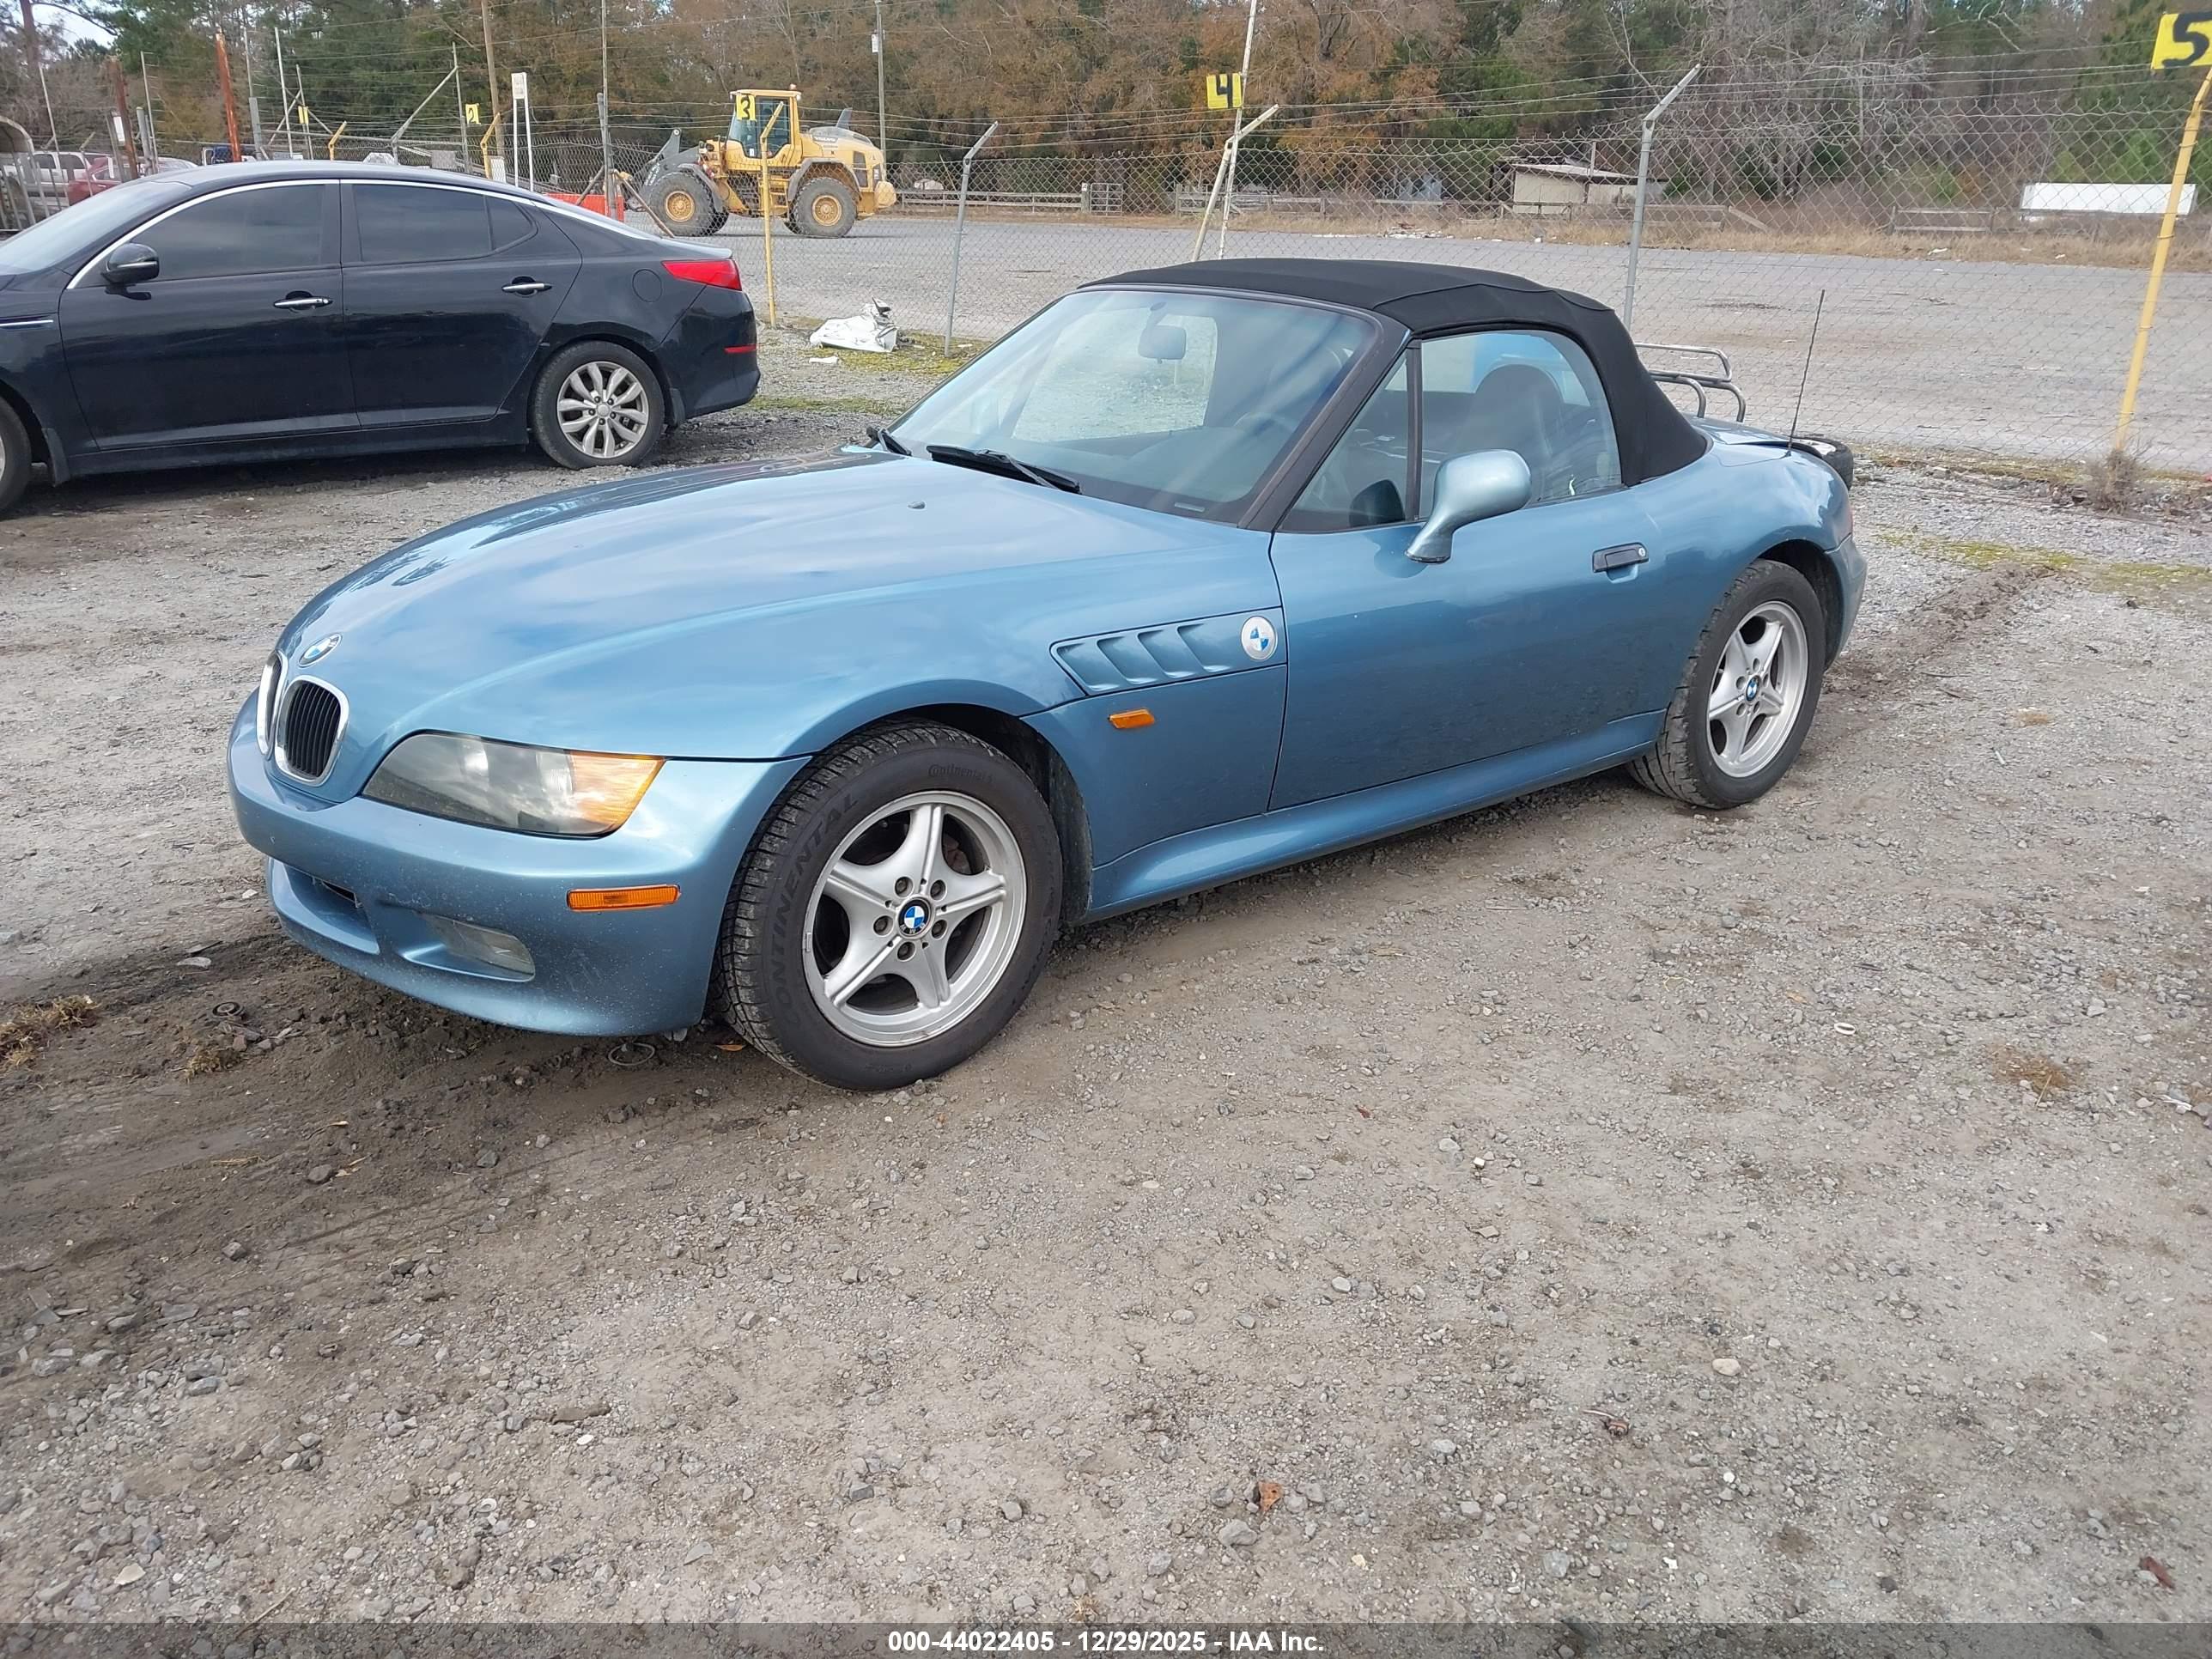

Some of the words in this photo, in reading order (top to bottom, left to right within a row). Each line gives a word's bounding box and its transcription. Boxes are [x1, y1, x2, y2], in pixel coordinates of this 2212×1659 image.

[2161, 12, 2212, 69] 5
[1215, 74, 1234, 109] 4
[468, 107, 477, 125] 2
[740, 94, 750, 120] 3
